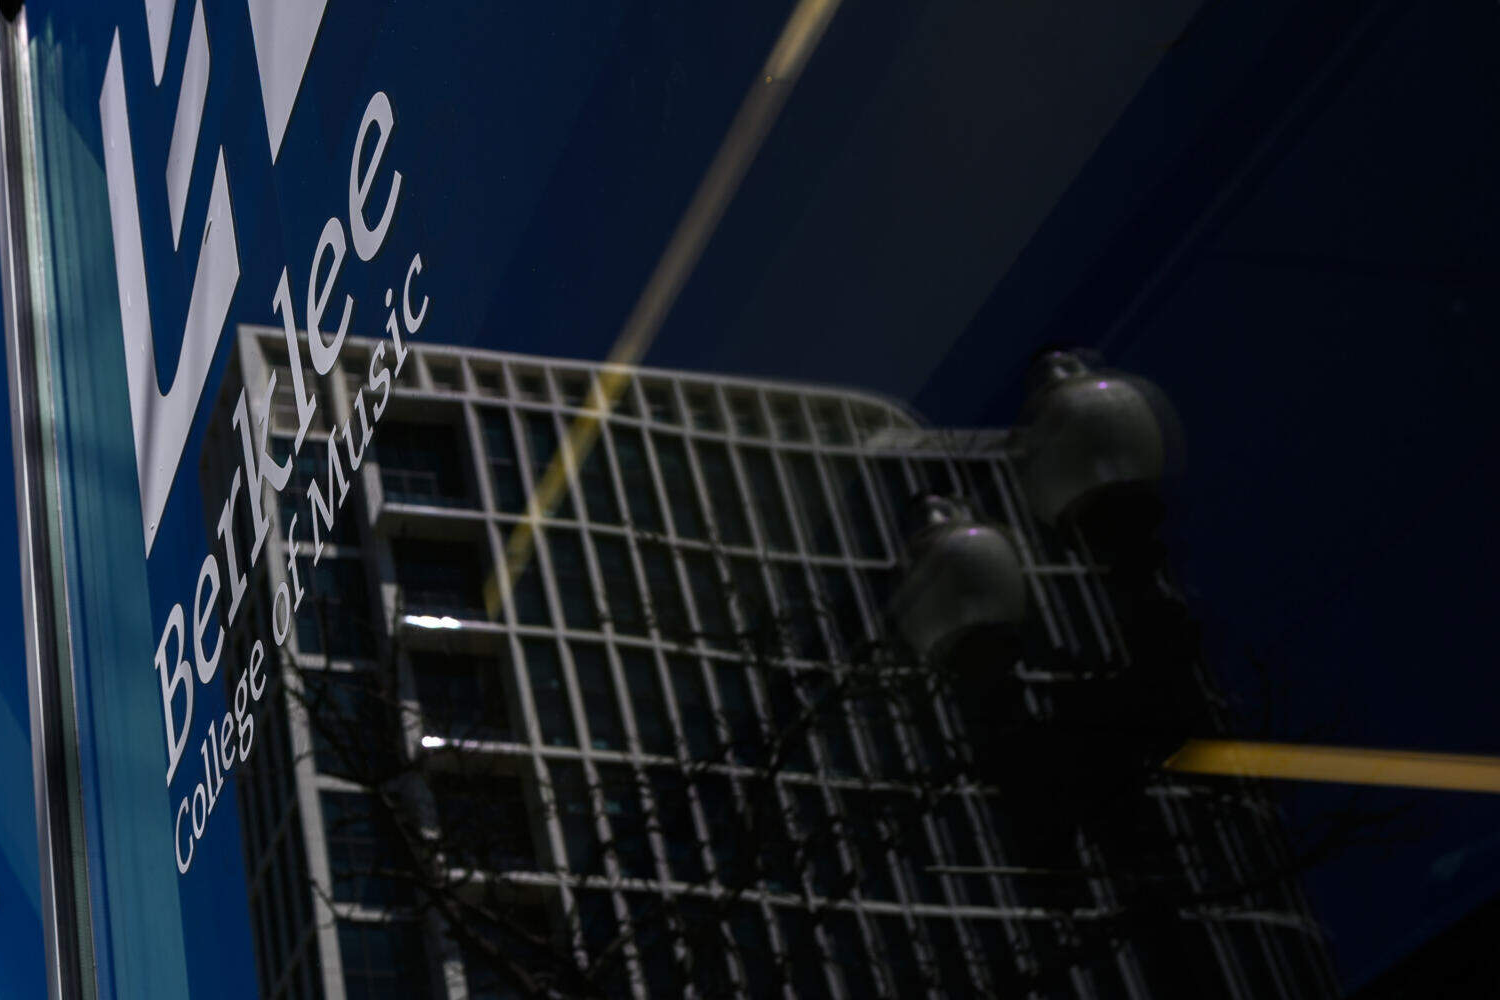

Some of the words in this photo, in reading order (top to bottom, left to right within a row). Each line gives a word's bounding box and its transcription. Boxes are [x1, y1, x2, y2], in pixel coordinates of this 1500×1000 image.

[154, 91, 403, 787] Berklee
[175, 639, 267, 874] College
[272, 513, 304, 646] of
[307, 252, 430, 567] Music
